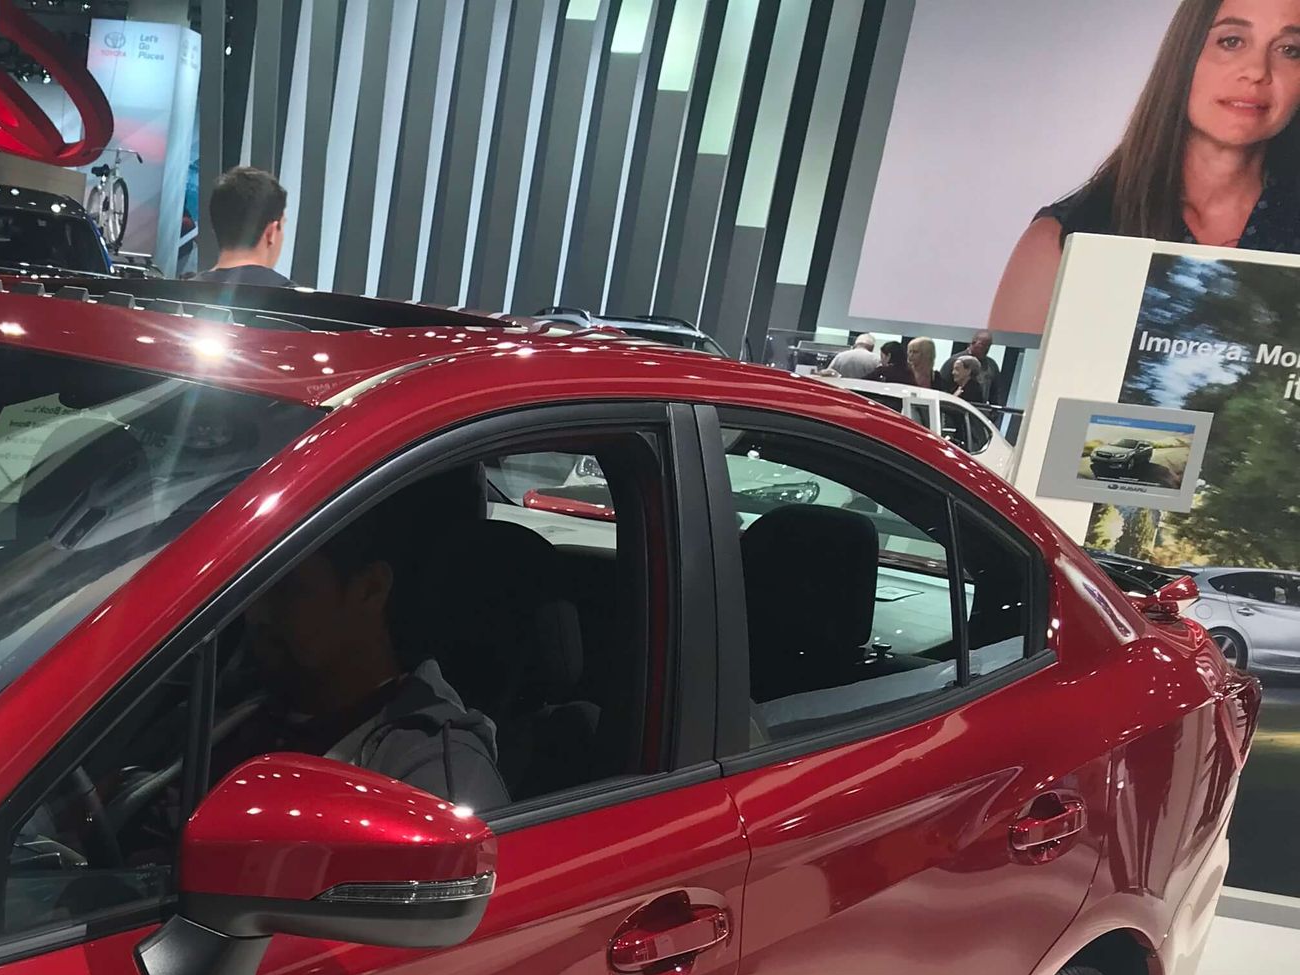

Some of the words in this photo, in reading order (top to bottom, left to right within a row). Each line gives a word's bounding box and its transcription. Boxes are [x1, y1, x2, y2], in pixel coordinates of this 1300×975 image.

[140, 34, 159, 43] Let's
[138, 51, 164, 61] Places
[1139, 331, 1248, 361] Impreza.
